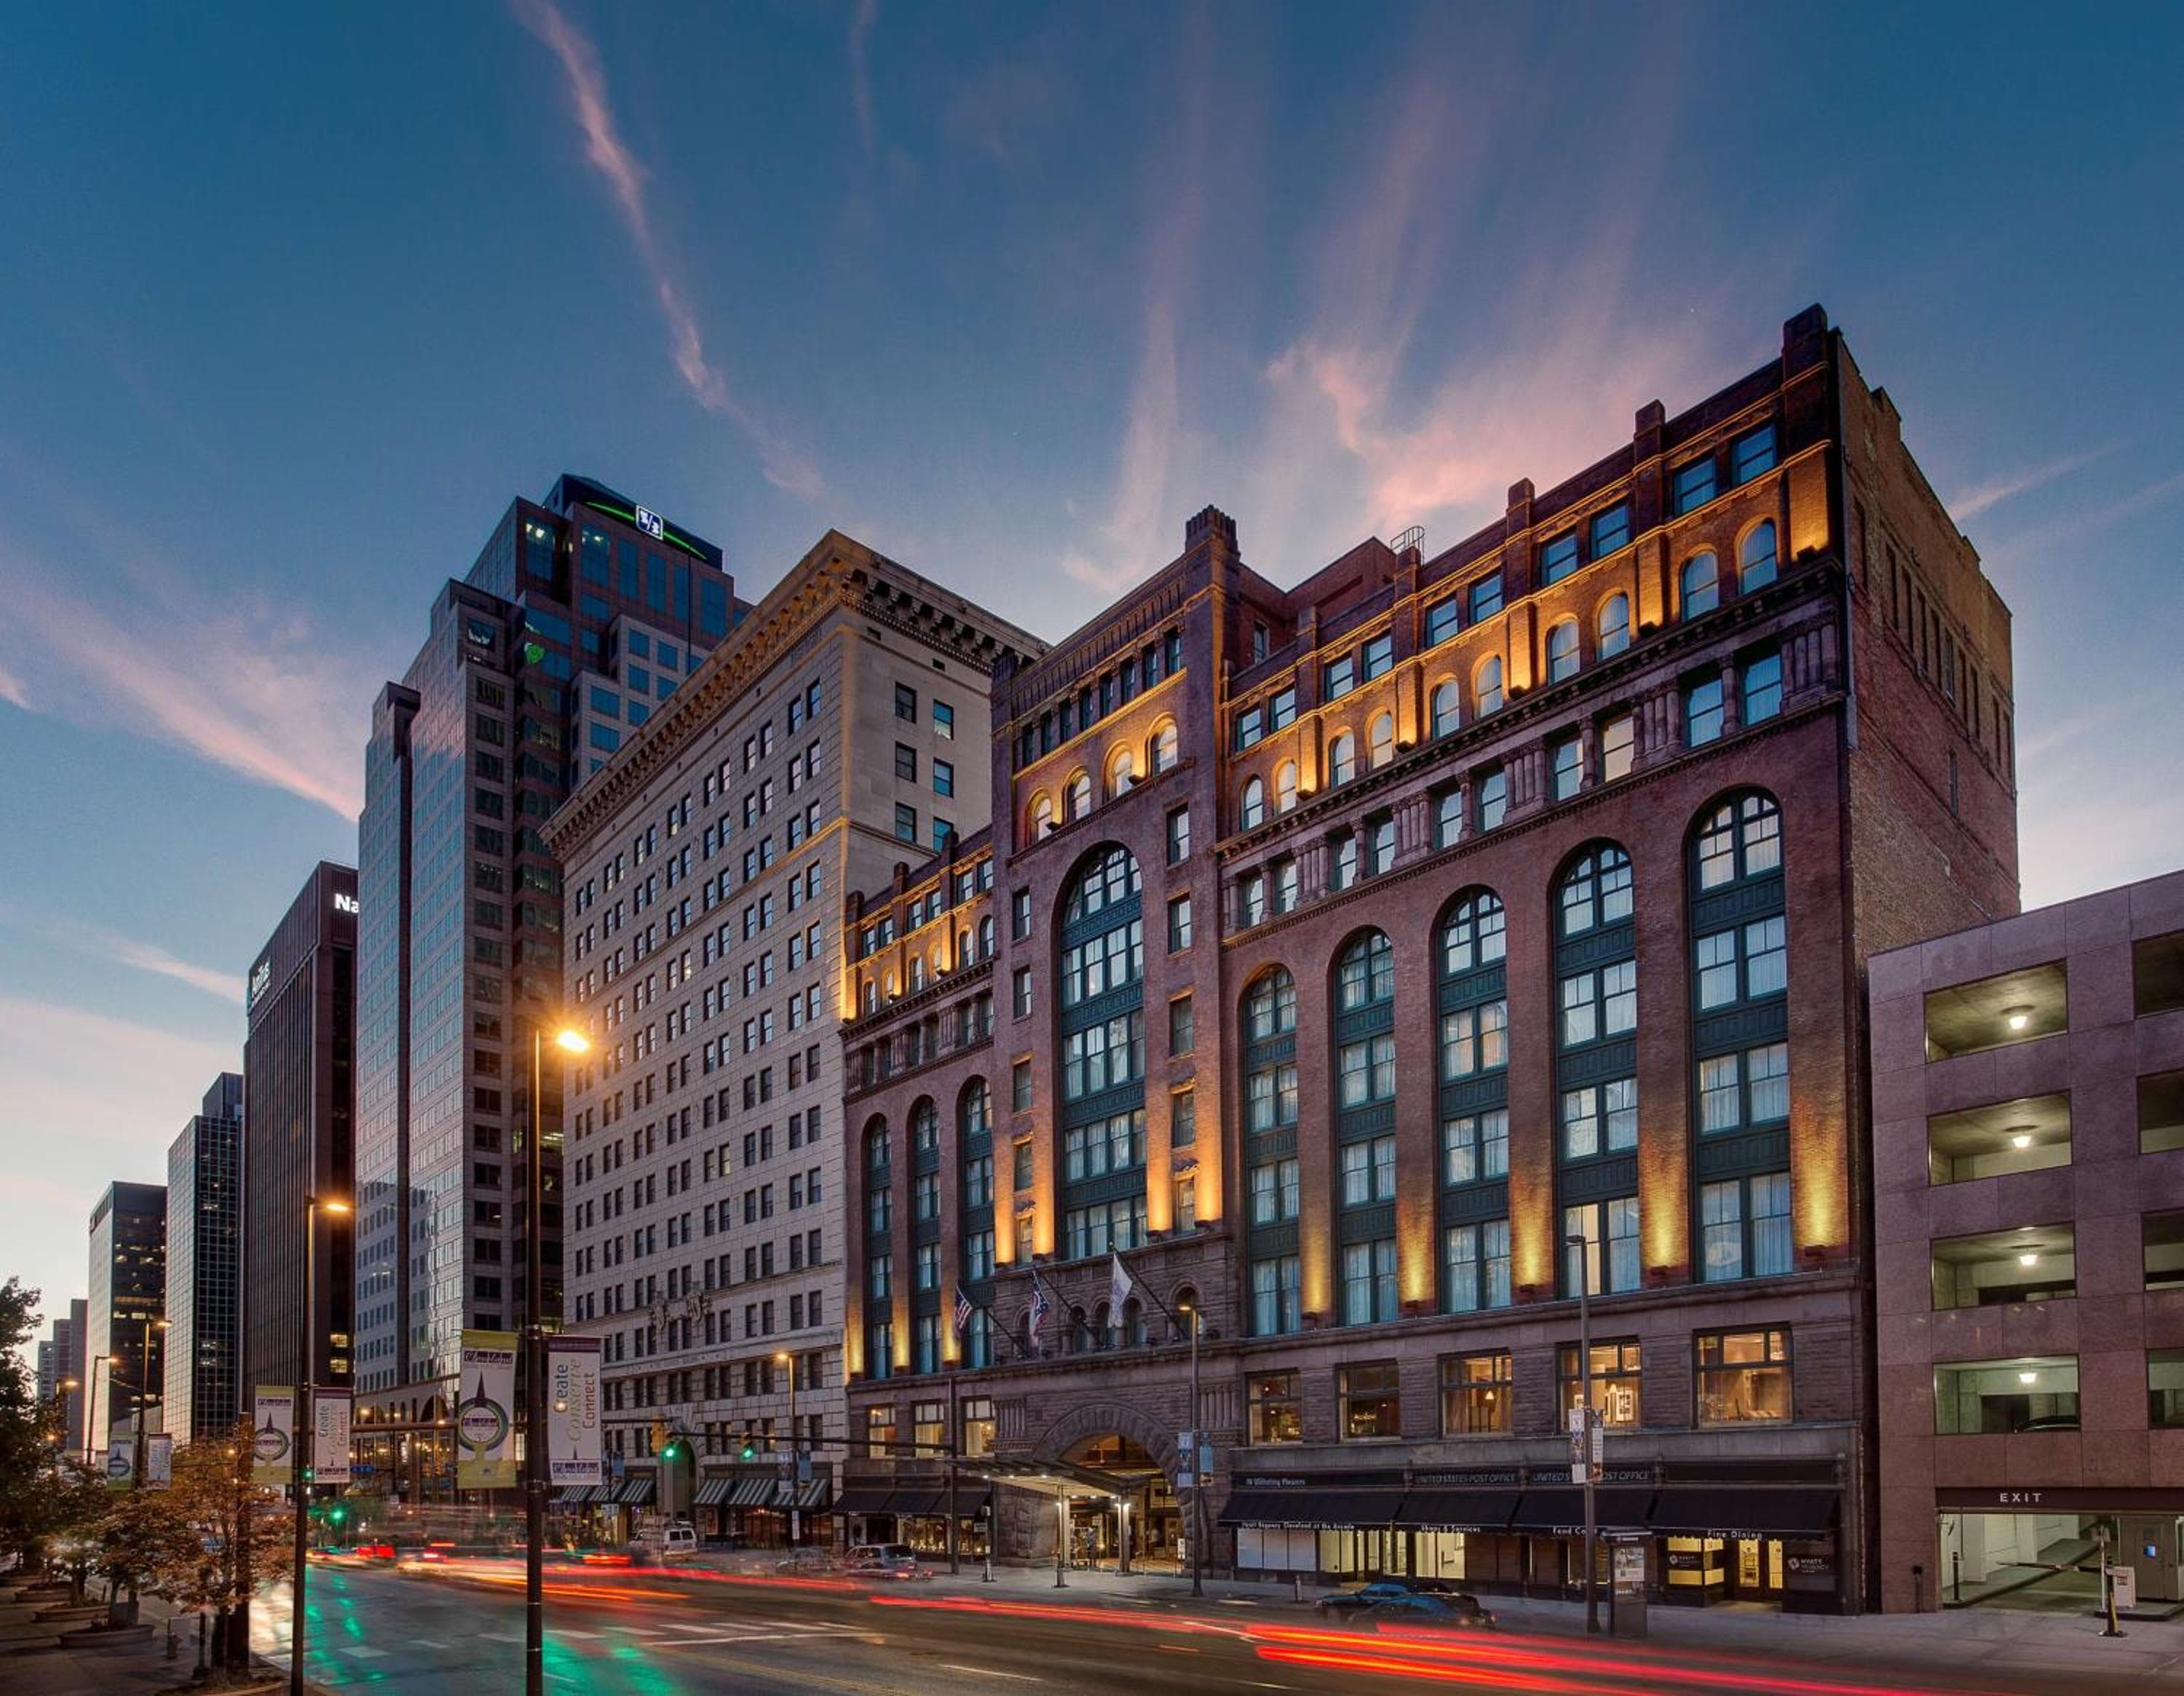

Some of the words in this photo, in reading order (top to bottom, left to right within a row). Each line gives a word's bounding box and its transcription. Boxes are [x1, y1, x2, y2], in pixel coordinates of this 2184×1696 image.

[553, 1364, 569, 1413] Create
[582, 1373, 596, 1430] Connect
[1469, 1473, 1488, 1483] POST
[1489, 1473, 1515, 1482] OFFICE
[1532, 1472, 1564, 1481] UNITED
[1601, 1471, 1618, 1481] OST
[1618, 1471, 1650, 1480] OFFICE
[2000, 1493, 2042, 1503] EXIT
[1421, 1524, 1440, 1532] Shops
[1452, 1525, 1481, 1533] Services
[1553, 1526, 1572, 1534] Food
[1707, 1530, 1726, 1538] Fine
[1730, 1531, 1762, 1540] Dining
